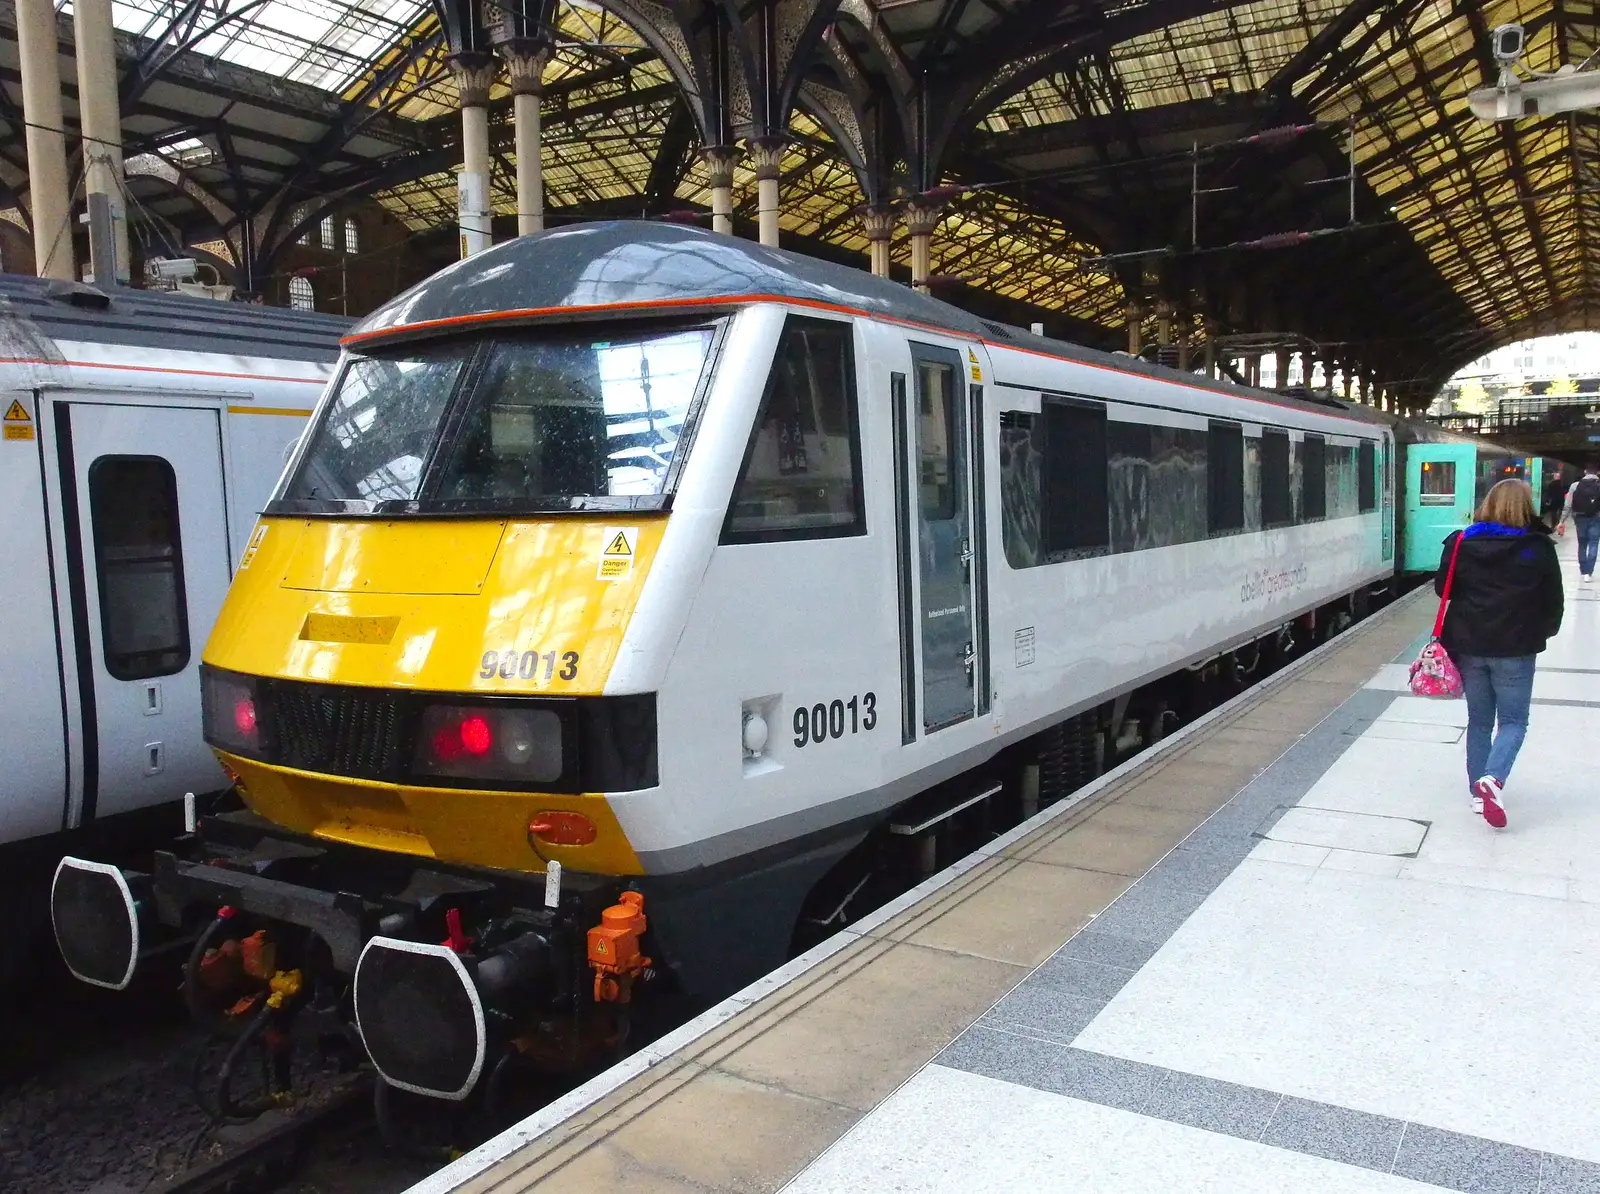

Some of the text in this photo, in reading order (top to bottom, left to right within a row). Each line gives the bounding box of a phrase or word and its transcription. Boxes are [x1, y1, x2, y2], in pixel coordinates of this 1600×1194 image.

[603, 560, 627, 568] Danger
[479, 649, 580, 681] 90013
[793, 692, 878, 748] 90013
